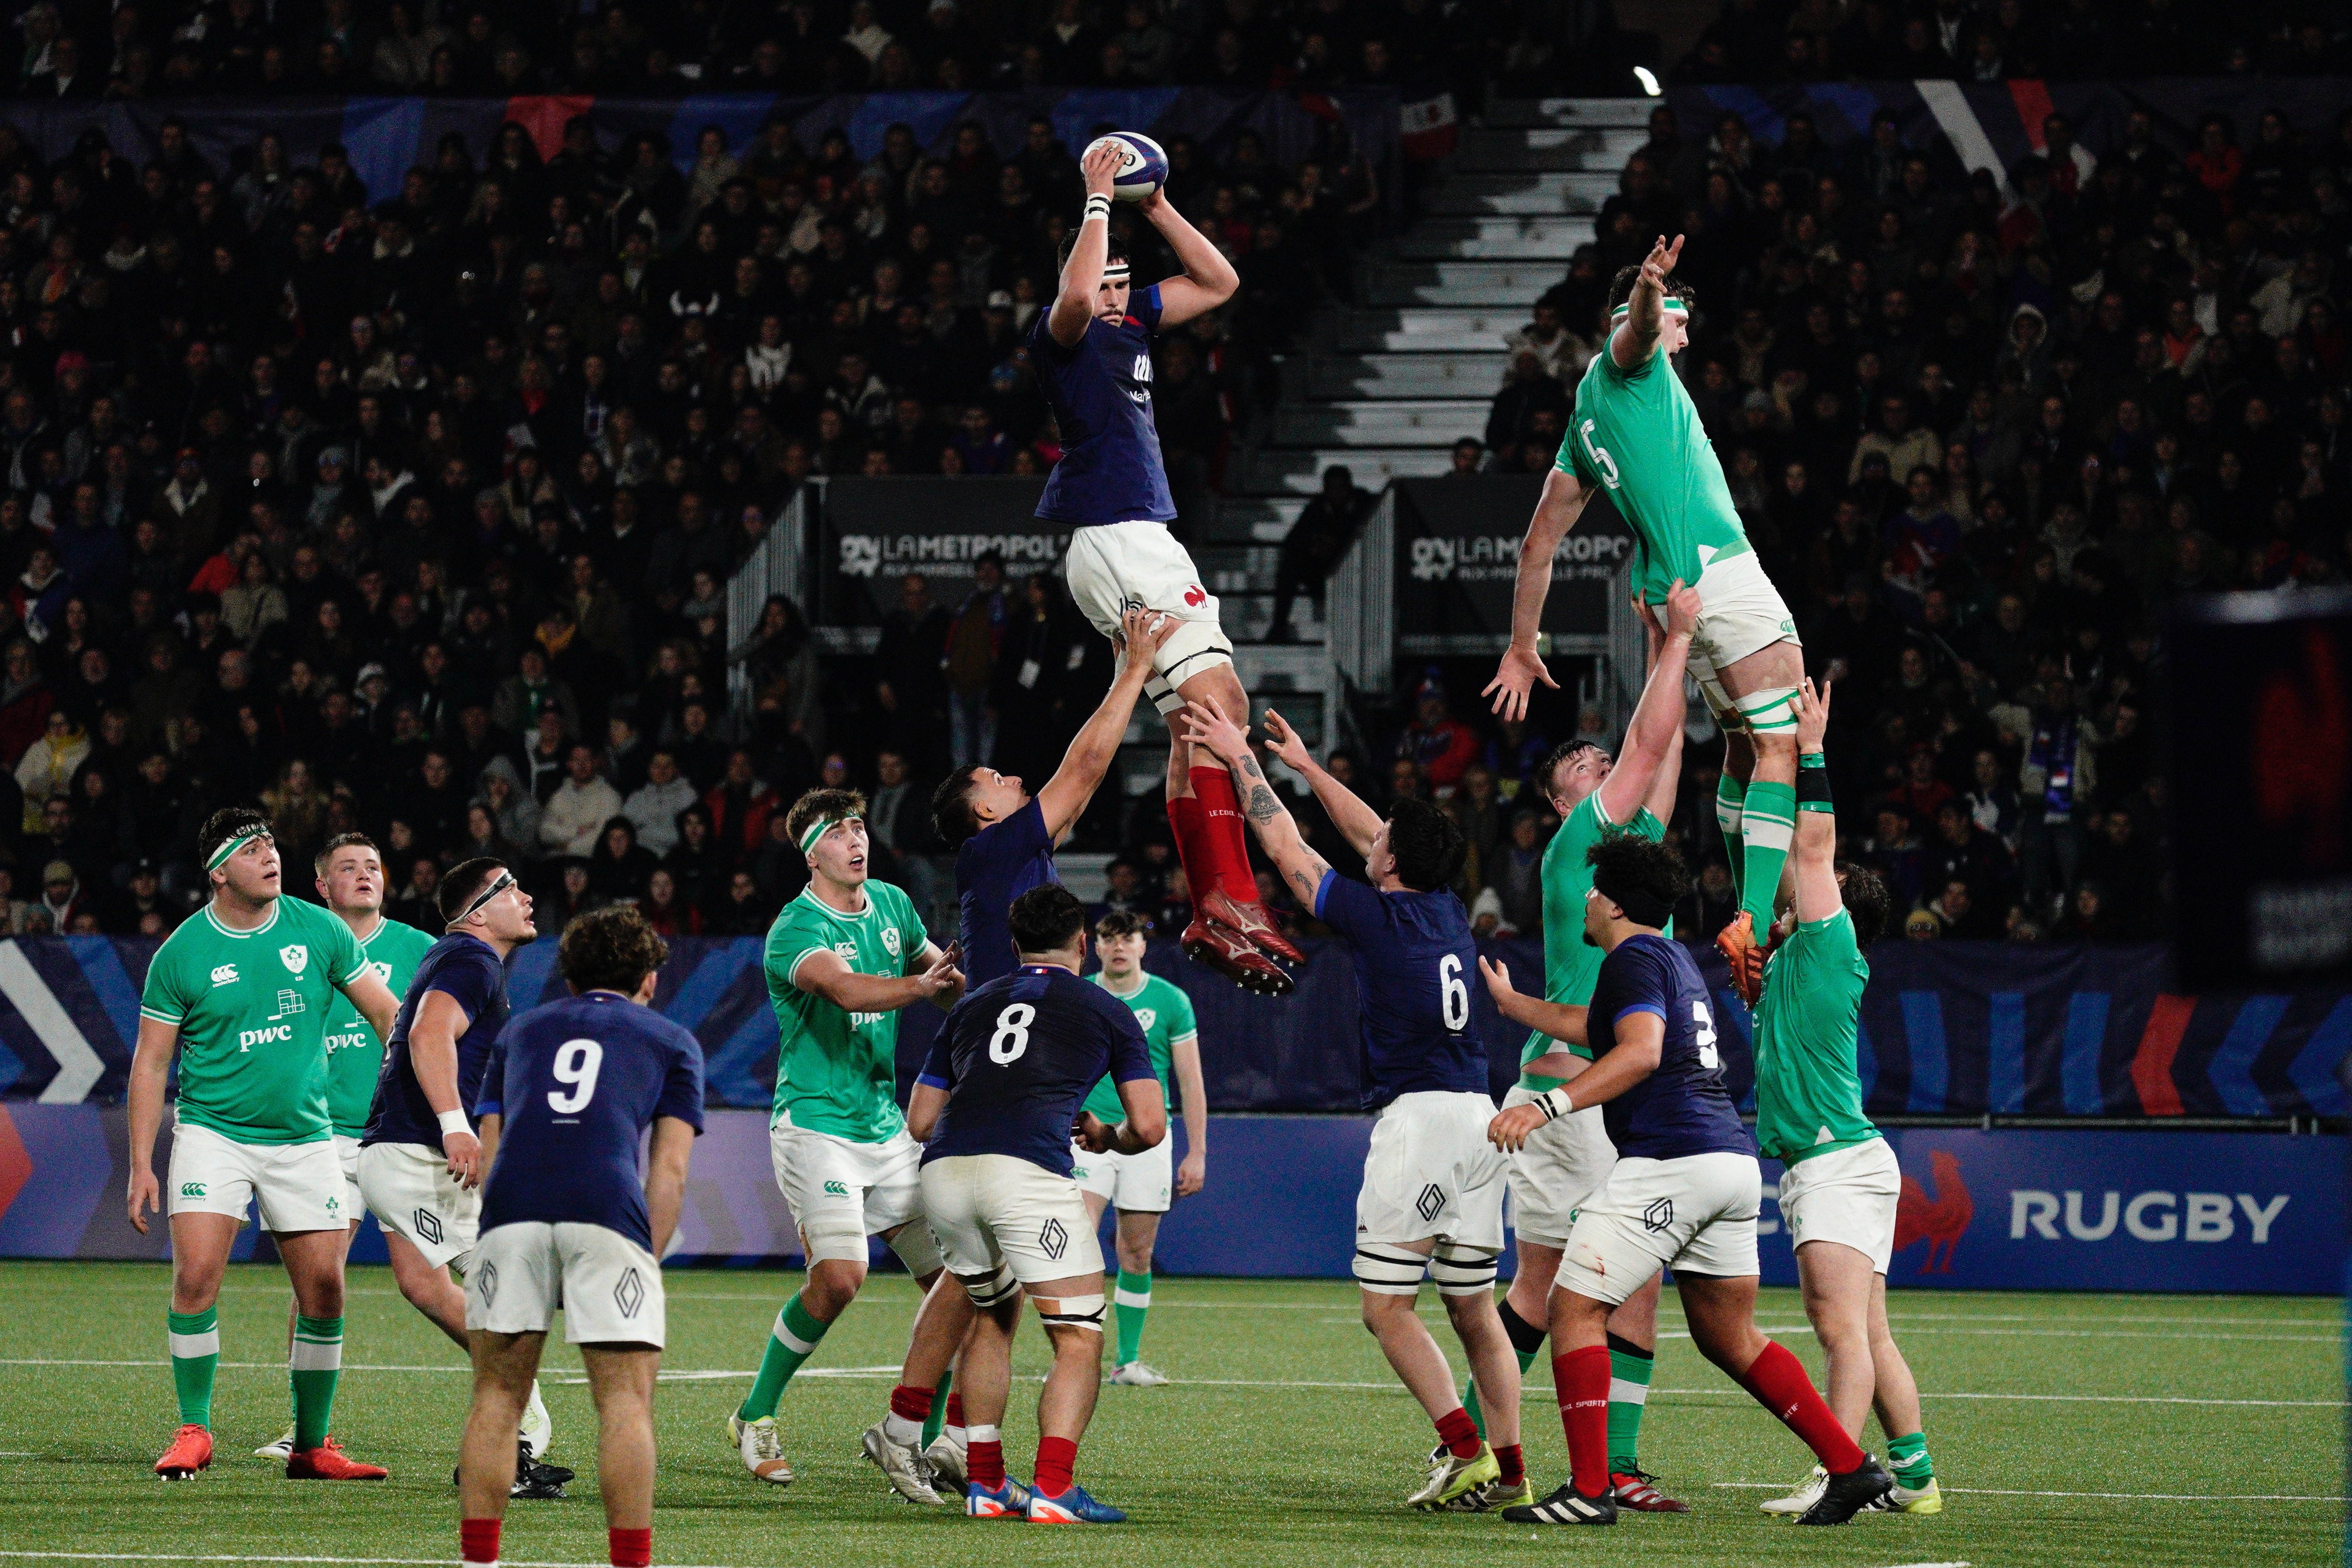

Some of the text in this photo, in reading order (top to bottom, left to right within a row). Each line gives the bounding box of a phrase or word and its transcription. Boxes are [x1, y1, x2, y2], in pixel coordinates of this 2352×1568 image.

[1580, 419, 1620, 489] 5
[212, 977, 239, 988] canterbury
[1440, 954, 1469, 1030] 6
[239, 1025, 291, 1052] pwc
[325, 1033, 366, 1054] pwc
[989, 1003, 1036, 1064] 8
[547, 1039, 603, 1114] 9
[2010, 1190, 2290, 1243] RUGBY
